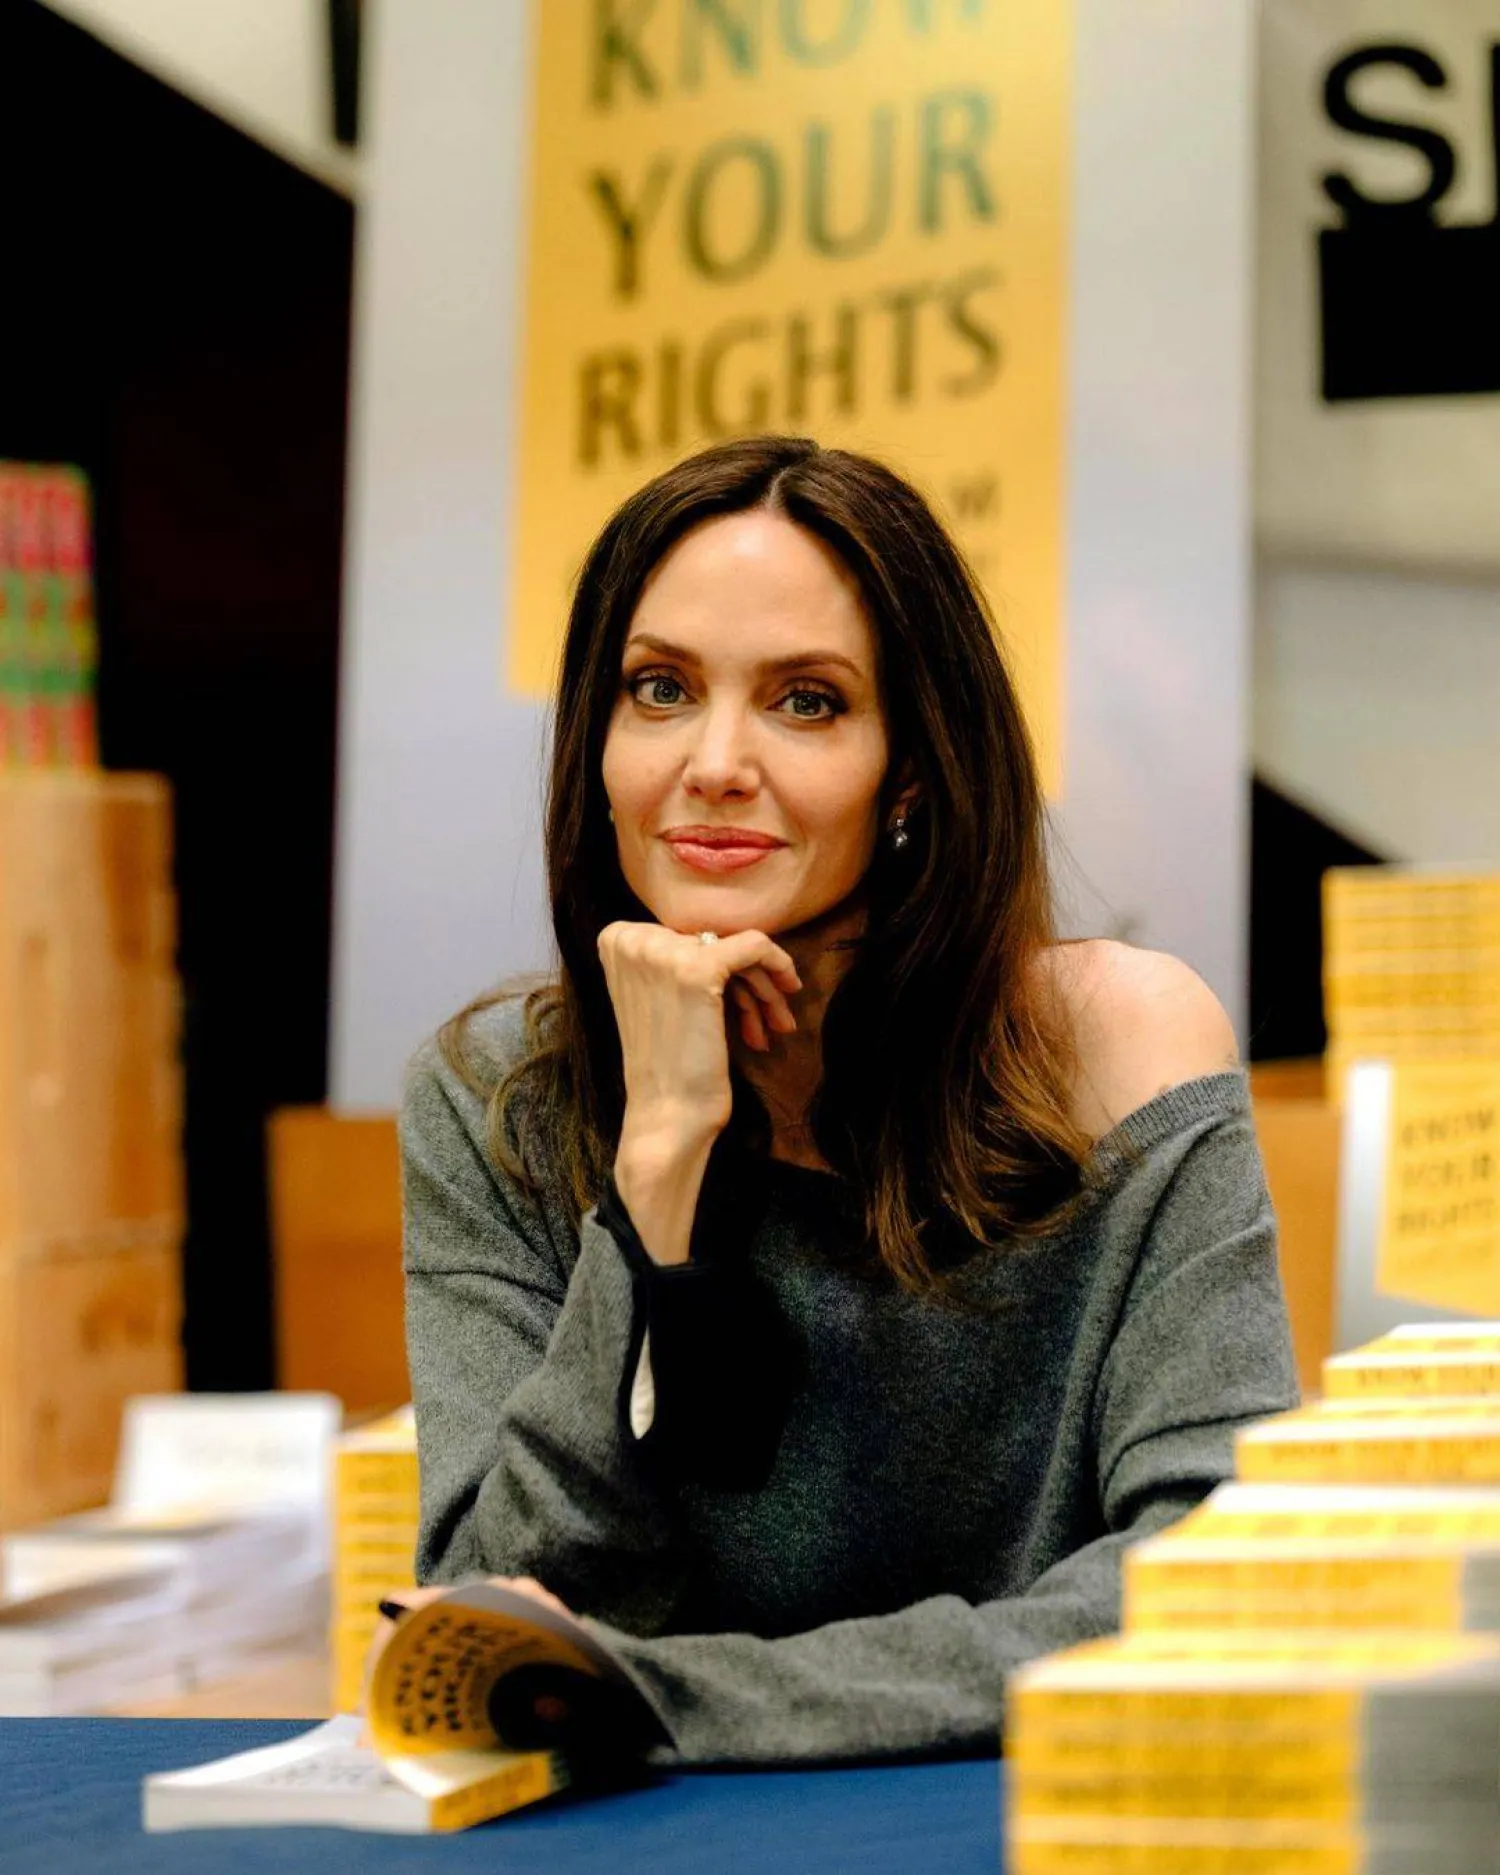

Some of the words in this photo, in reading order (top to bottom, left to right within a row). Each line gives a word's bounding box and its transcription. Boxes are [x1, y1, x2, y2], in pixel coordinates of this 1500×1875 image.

[588, 0, 985, 112] KNO
[590, 84, 998, 307] YOUR
[576, 266, 1005, 470] RIGHTS
